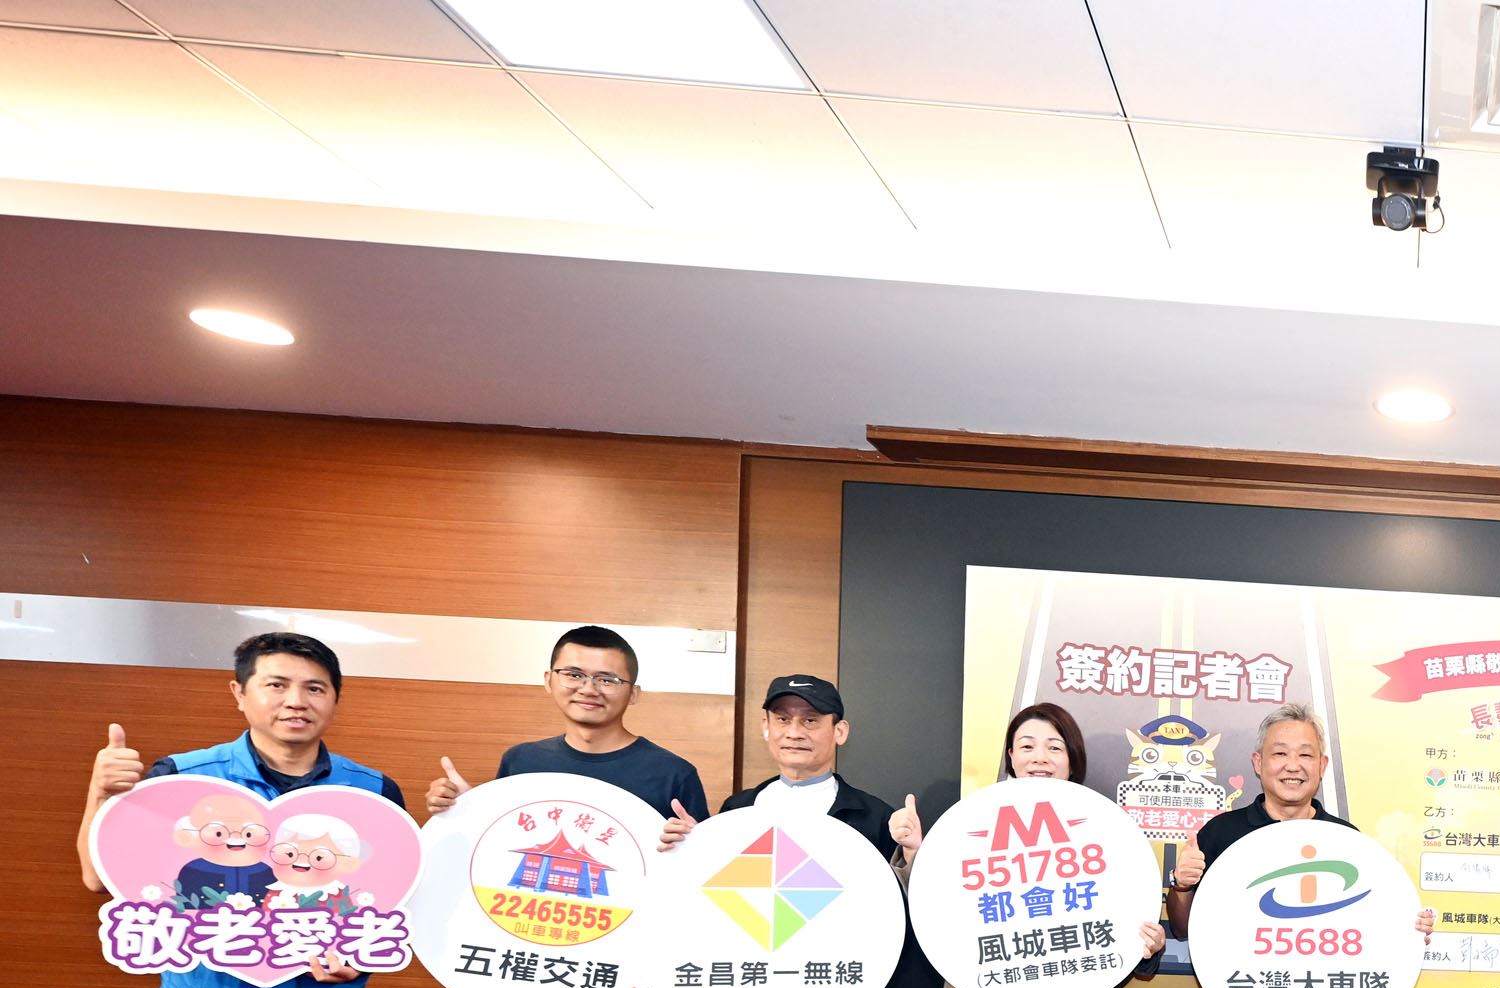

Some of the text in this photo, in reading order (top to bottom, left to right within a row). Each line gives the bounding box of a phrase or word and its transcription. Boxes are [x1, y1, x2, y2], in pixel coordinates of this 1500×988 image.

[1057, 643, 1292, 703] 簽約記者會
[1164, 727, 1185, 735] TAXI
[1139, 795, 1205, 808] 可使用苗栗縣
[1162, 784, 1181, 794] 本車
[990, 801, 1071, 852] M
[961, 844, 1107, 891] 551788
[1424, 871, 1454, 882] 簽約人
[489, 893, 613, 931] 22465555
[978, 881, 1099, 924] 都會好
[110, 901, 408, 967] 敬老愛老
[514, 922, 581, 942] 叫車專線
[978, 919, 1116, 965] 風城車隊
[1254, 927, 1363, 956] 55688
[674, 960, 864, 987] 金昌第一無線
[977, 952, 1124, 988] (大都會車隊委託)
